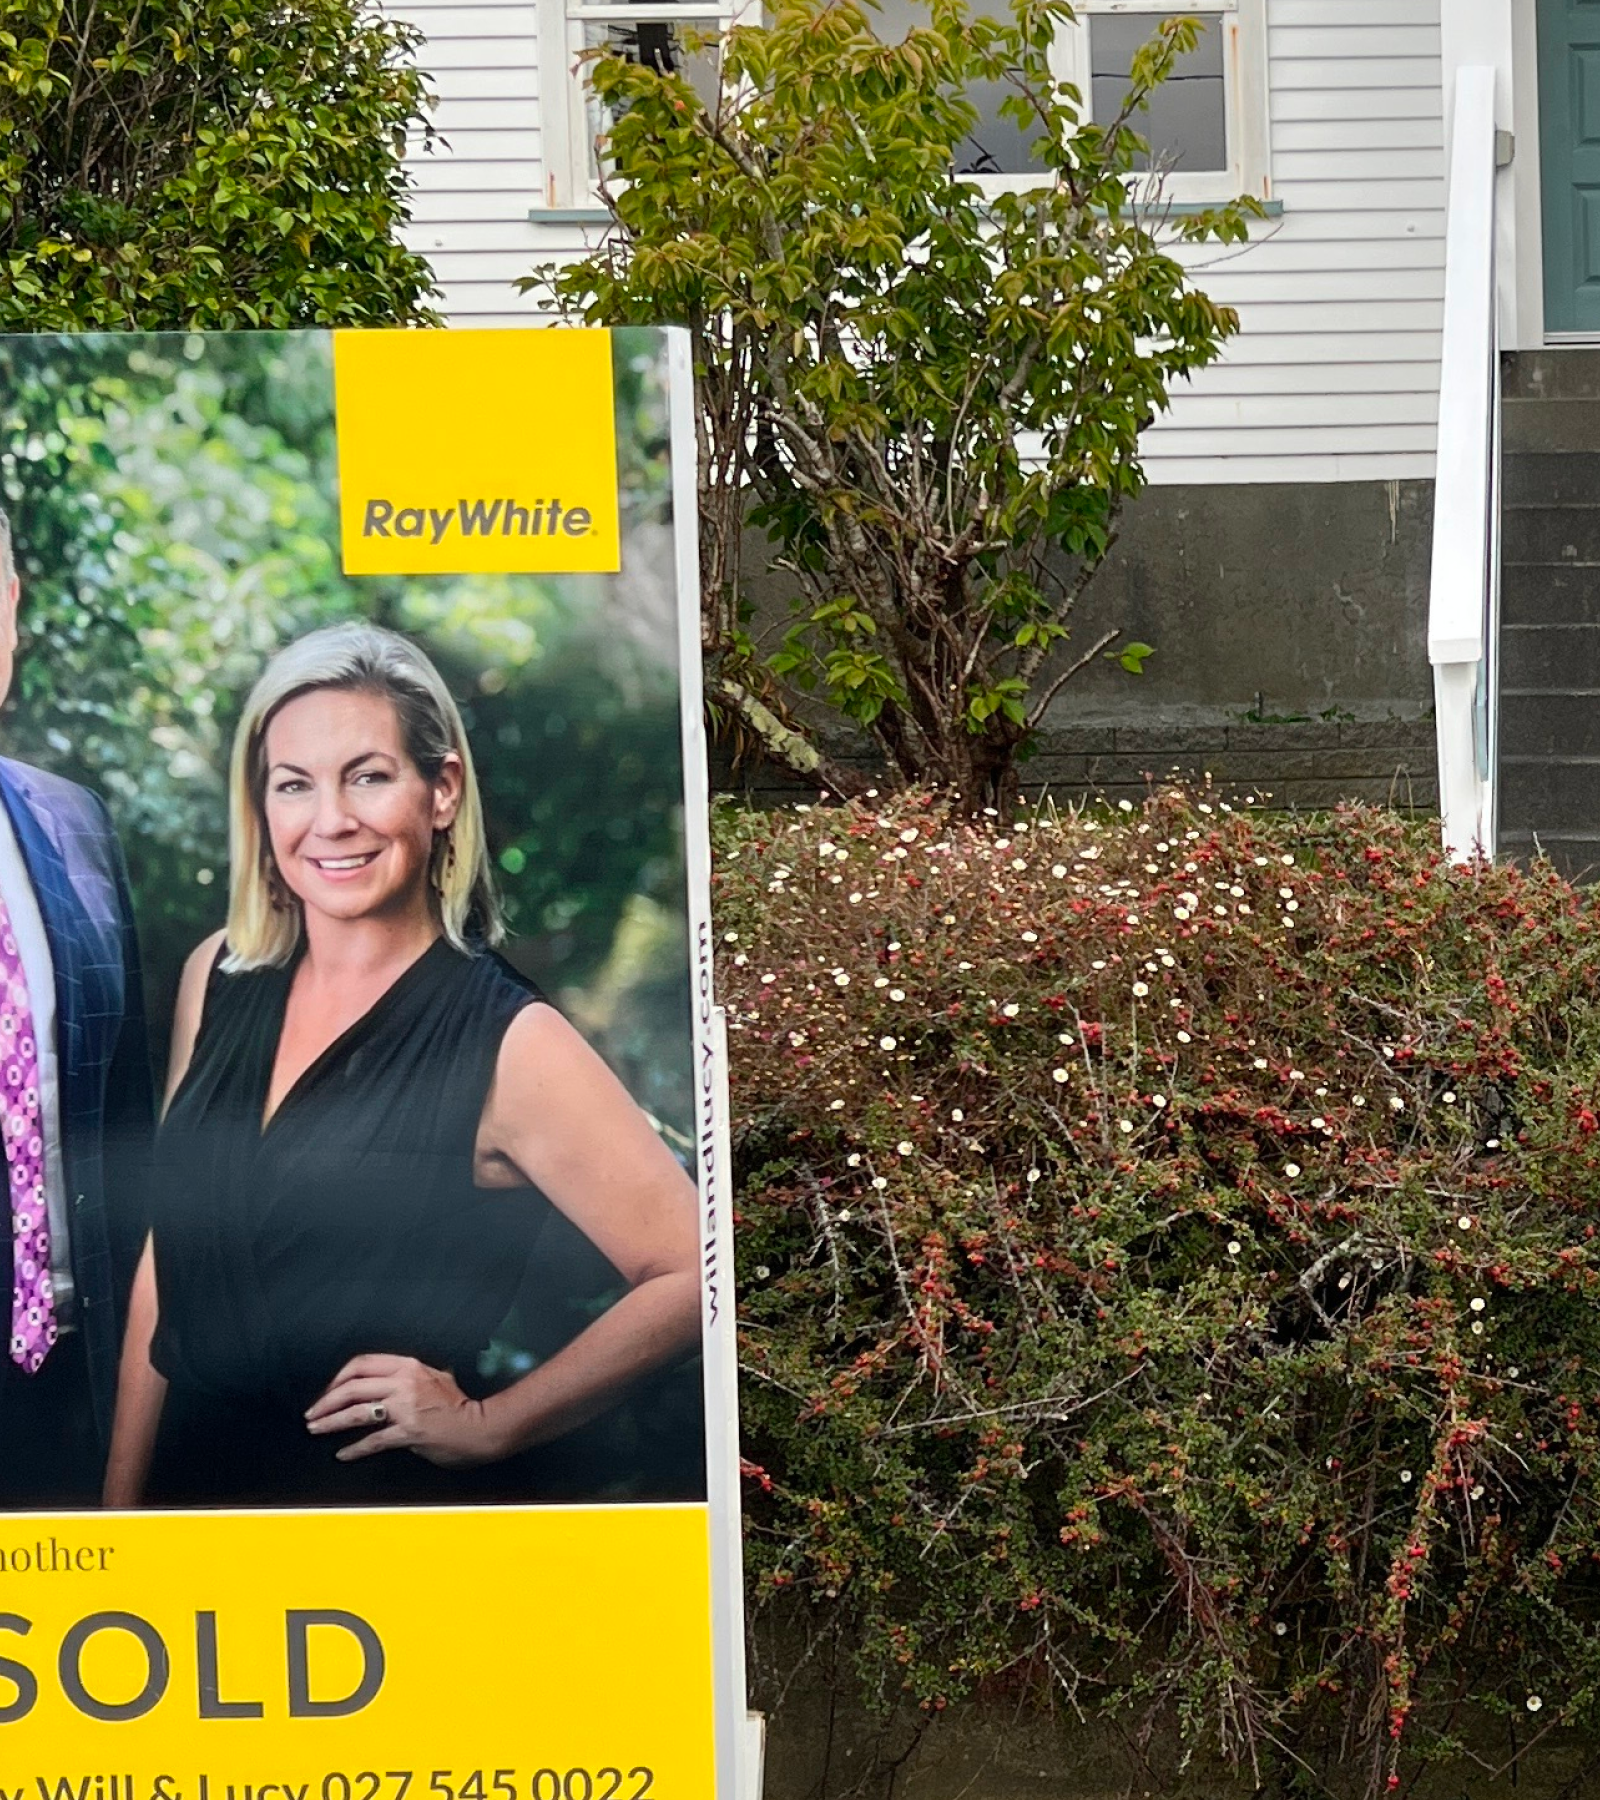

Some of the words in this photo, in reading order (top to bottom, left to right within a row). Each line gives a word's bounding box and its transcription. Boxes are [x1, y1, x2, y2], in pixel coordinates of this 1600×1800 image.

[363, 499, 592, 544] RayWhite
[698, 921, 719, 1328] willandlucy.com
[0, 1608, 386, 1724] SOLD
[36, 1774, 133, 1800] Will
[150, 1774, 182, 1800] &
[321, 1771, 413, 1800] 027
[429, 1769, 518, 1800] 545
[532, 1766, 655, 1800] 0022
